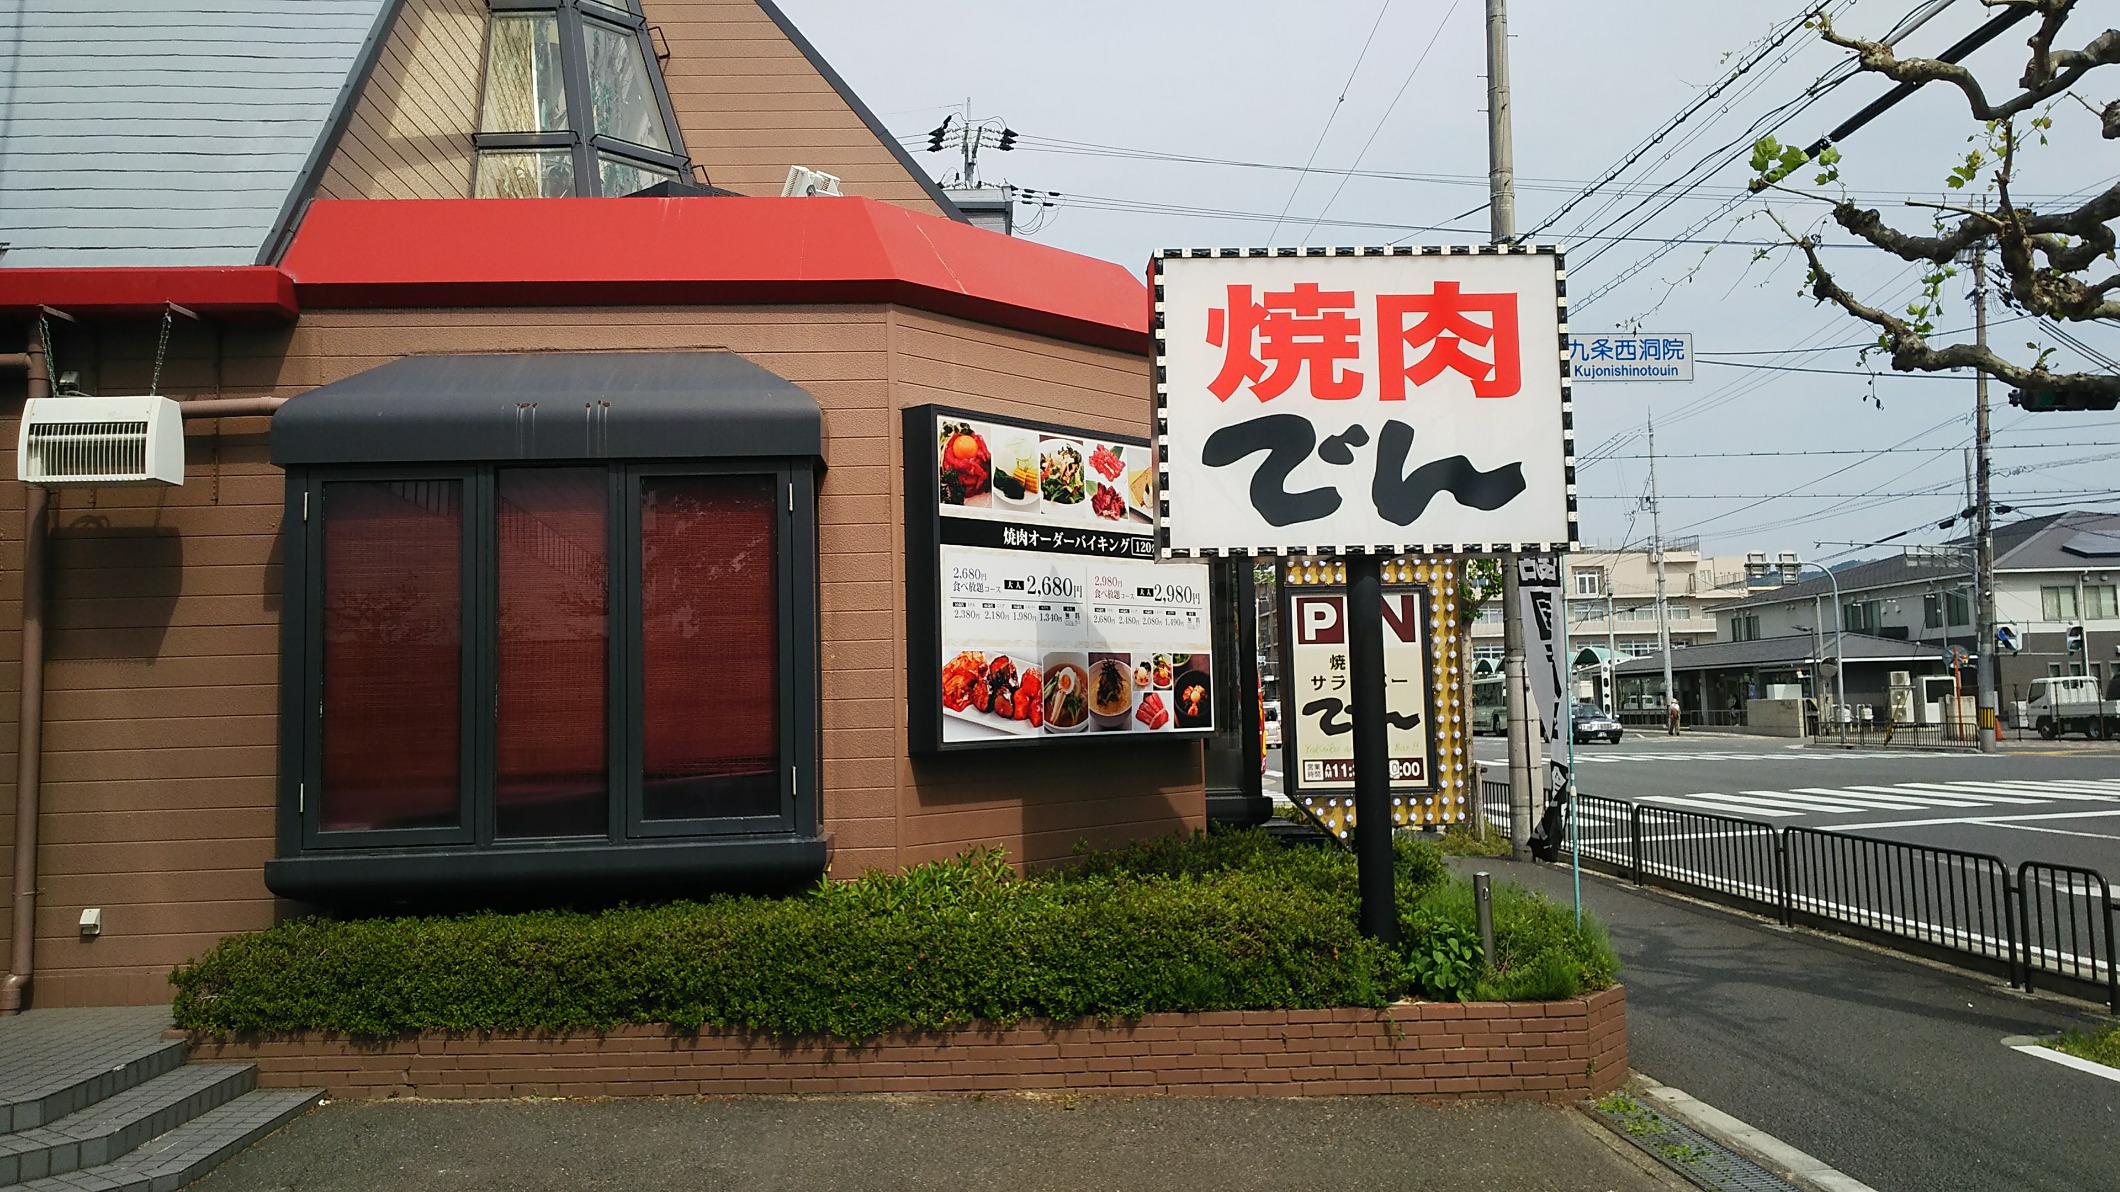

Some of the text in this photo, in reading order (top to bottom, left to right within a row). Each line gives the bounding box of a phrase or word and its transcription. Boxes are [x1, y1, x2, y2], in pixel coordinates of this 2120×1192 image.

[1206, 281, 1522, 403] 焼肉
[1569, 338, 1685, 362] 九条西洞院
[1574, 365, 1679, 379] Kujonishinotouin
[1202, 414, 1527, 527] でん
[1003, 526, 1131, 554] 焼肉オーダーバイキング
[953, 567, 987, 581] 2,680円
[1094, 575, 1123, 587] 2,980円
[953, 581, 1002, 593] 食べ放題コース
[1027, 575, 1083, 598] 2,680円
[1094, 588, 1135, 600] 食べ放題コース
[1154, 583, 1200, 605] 2,980円
[1303, 602, 1338, 641] P
